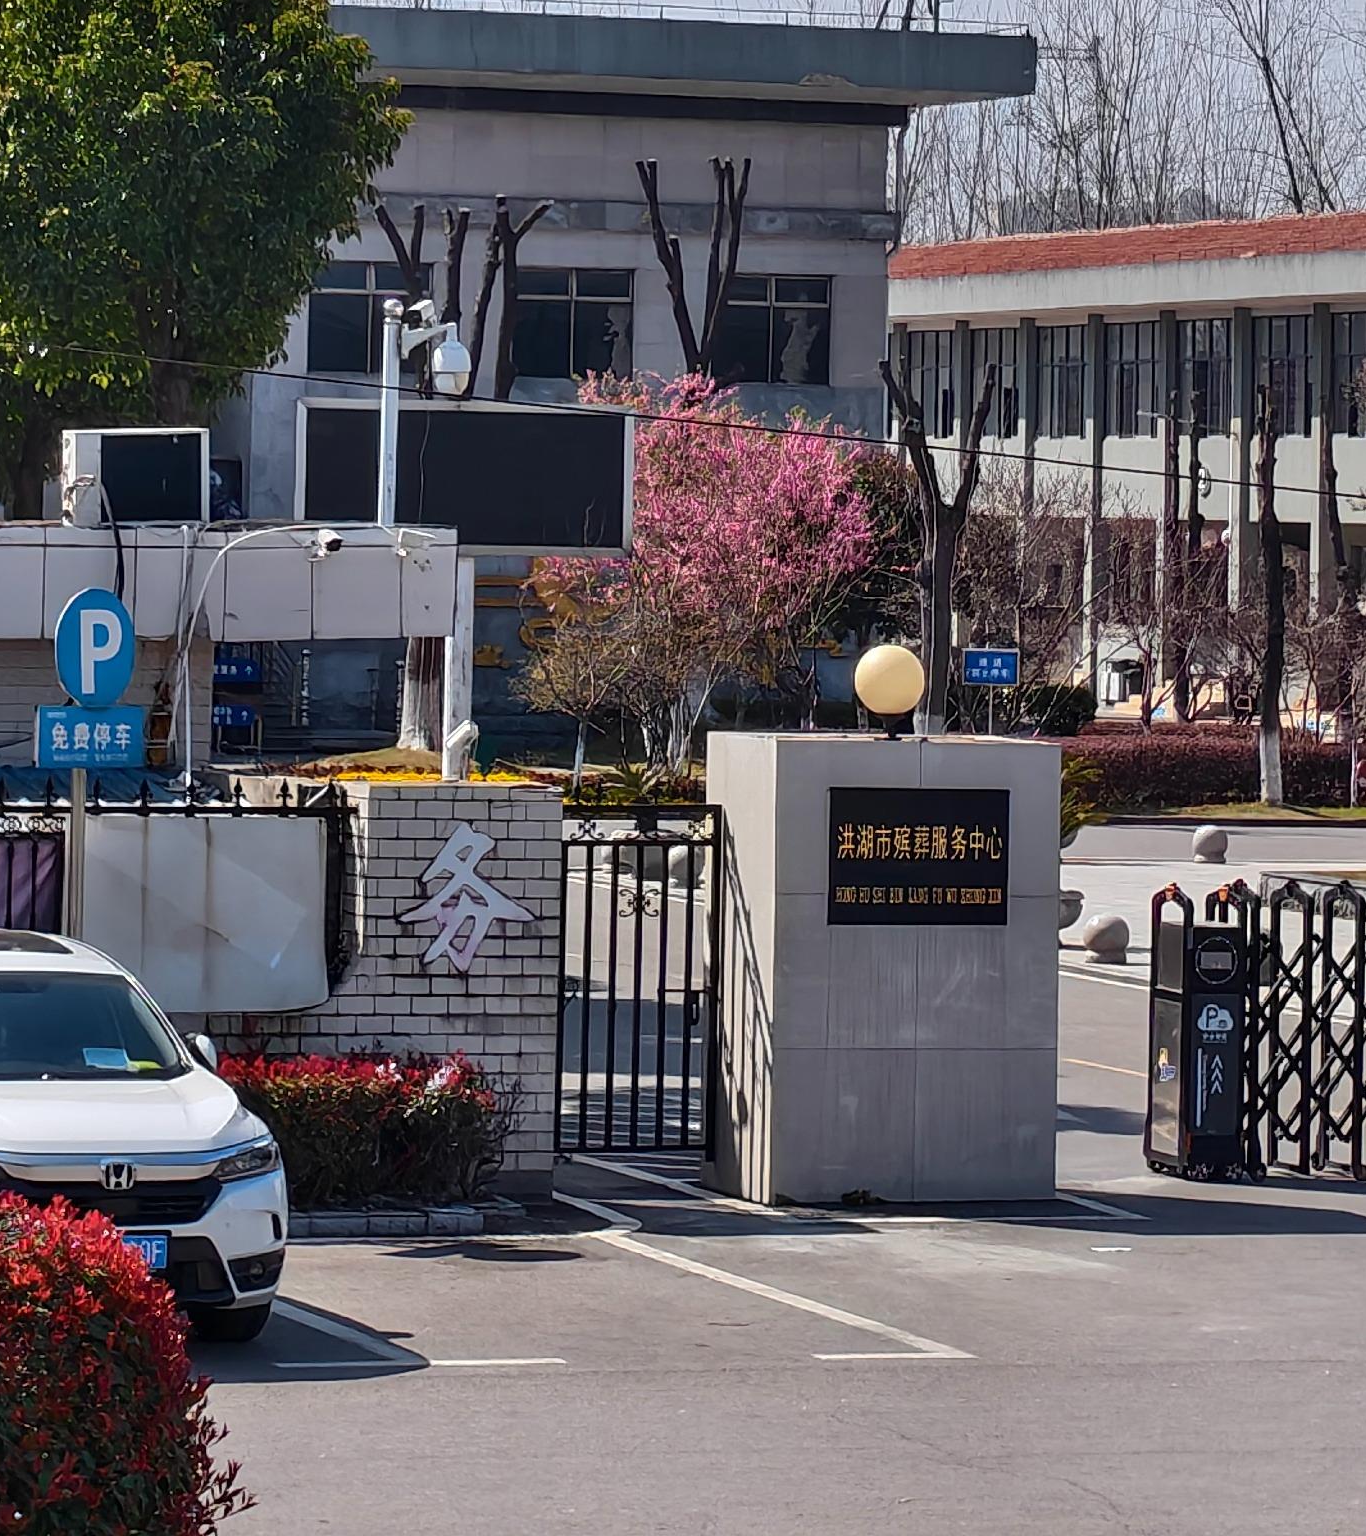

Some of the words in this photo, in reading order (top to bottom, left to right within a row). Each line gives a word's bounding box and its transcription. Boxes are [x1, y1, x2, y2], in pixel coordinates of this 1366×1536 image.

[80, 609, 123, 695] P
[51, 721, 132, 752] 免费停车
[836, 823, 1004, 861] 洪湖市殡葬服务中心
[397, 821, 536, 973] 务
